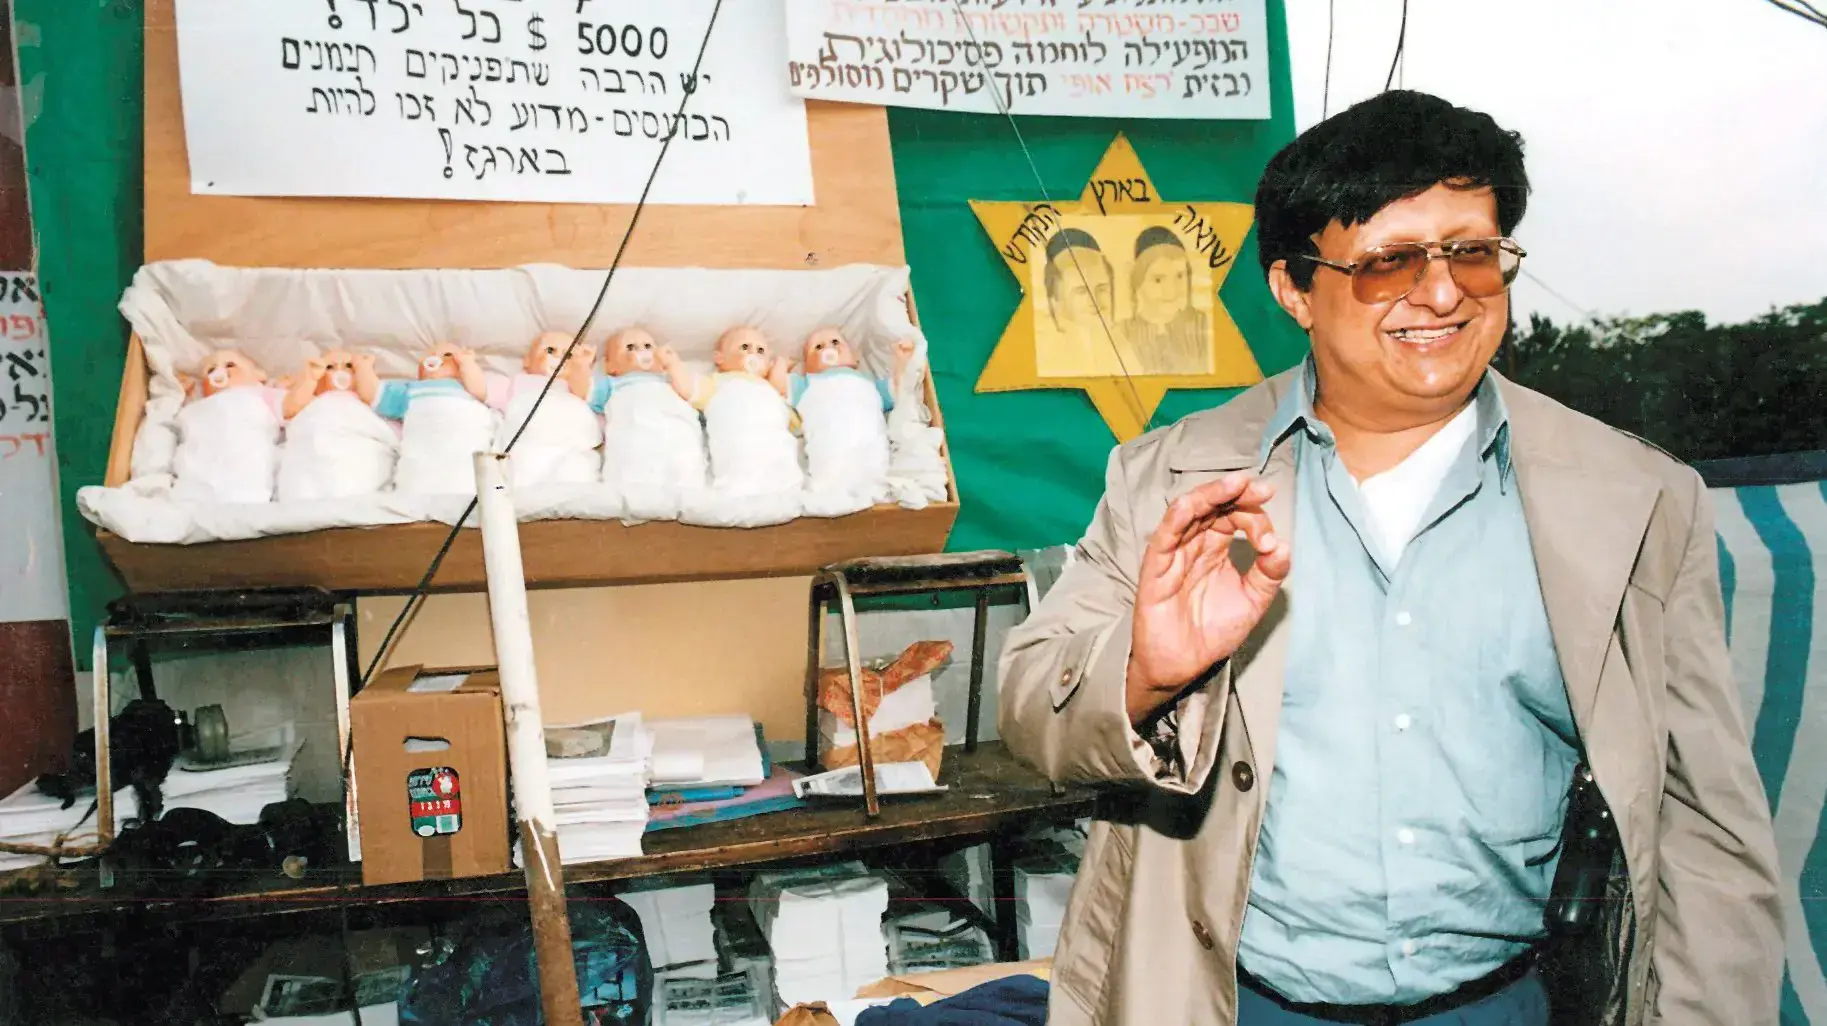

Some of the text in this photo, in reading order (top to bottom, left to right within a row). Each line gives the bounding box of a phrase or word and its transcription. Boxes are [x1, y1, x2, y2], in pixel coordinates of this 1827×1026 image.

[455, 0, 501, 43] כל
[527, 12, 547, 52] $
[578, 22, 668, 59] 5000
[281, 37, 377, 74] תימנים
[819, 30, 1248, 70] המפעילה לוחמה פסיכולוגית
[305, 75, 376, 116] להיות
[579, 67, 667, 95] הרבה
[679, 72, 712, 94] יש
[892, 69, 985, 106] שקרים
[993, 71, 1048, 111] תוך
[1182, 72, 1252, 99] ובזית
[395, 92, 436, 121] זכו
[454, 85, 492, 126] לא
[1001, 178, 1232, 269] שואה בארץ הקודש
